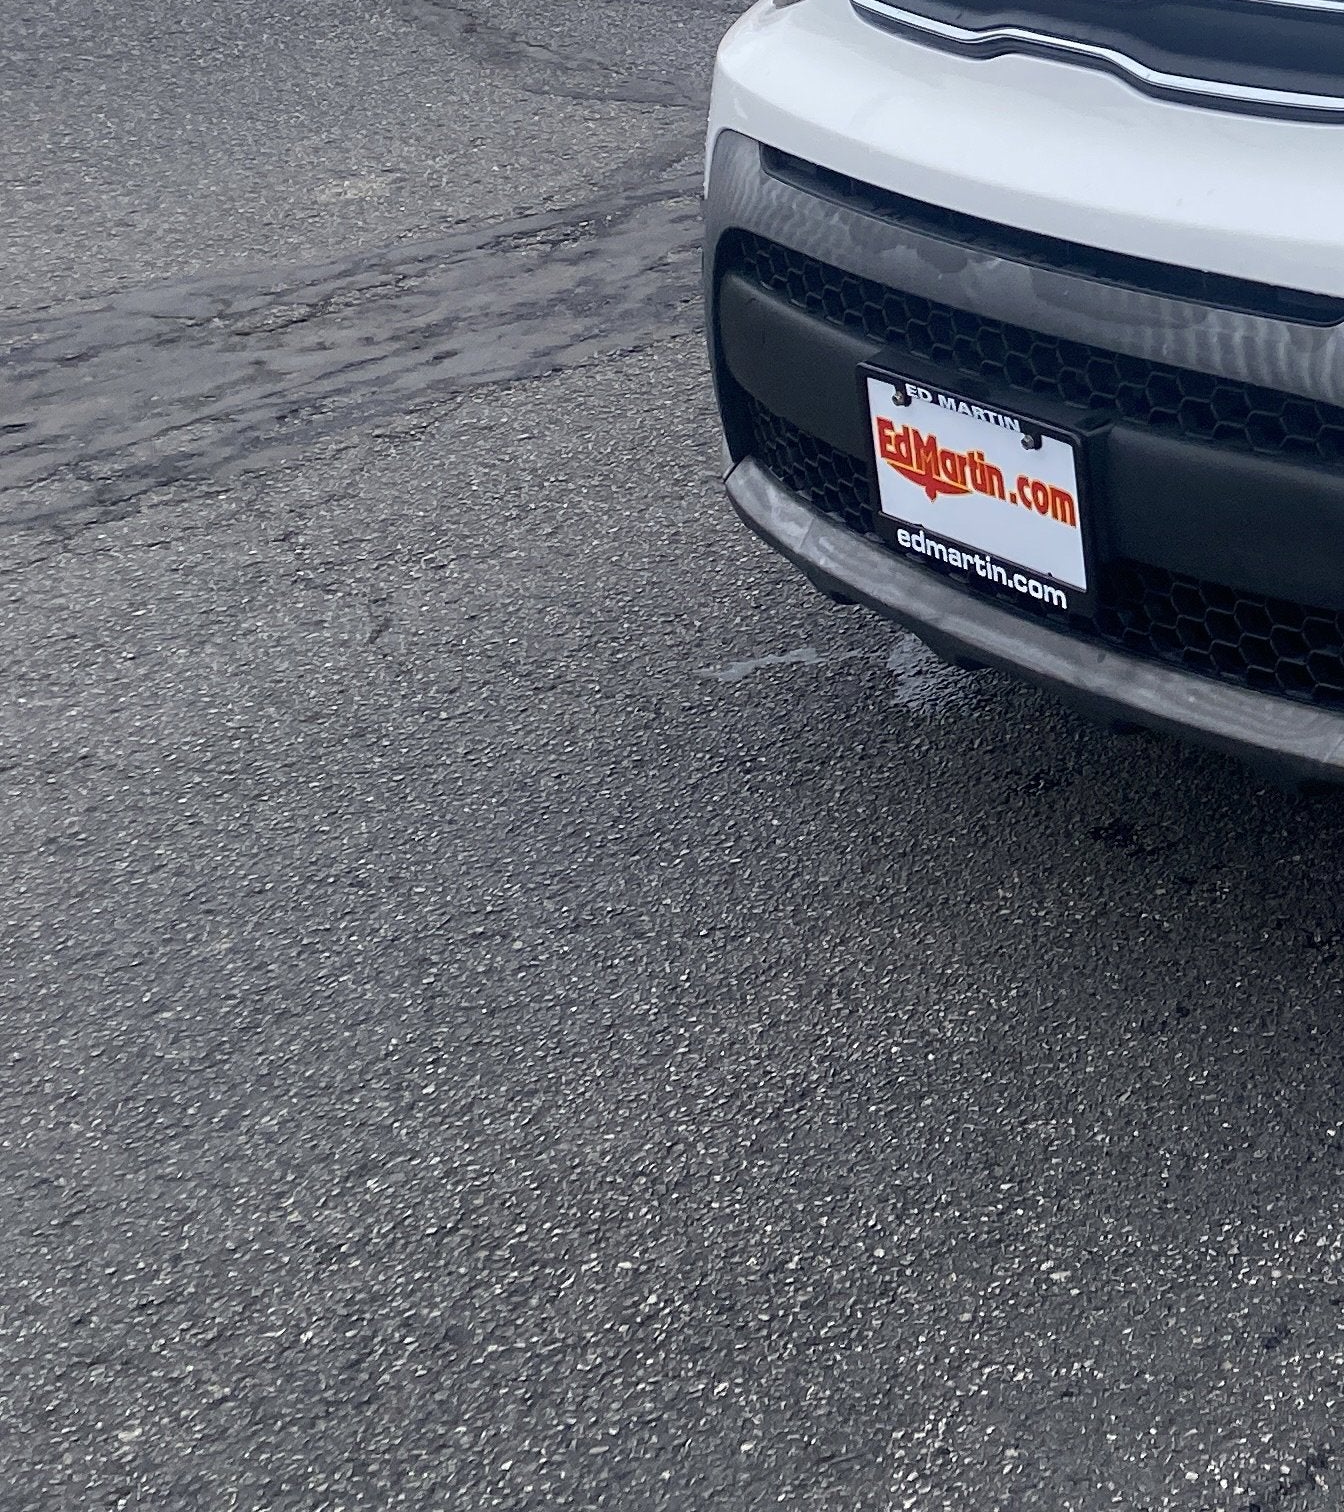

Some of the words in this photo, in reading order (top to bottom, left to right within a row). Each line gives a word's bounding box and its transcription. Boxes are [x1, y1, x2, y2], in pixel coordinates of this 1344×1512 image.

[904, 383, 934, 403] ED
[938, 394, 1022, 432] MARTIN
[896, 527, 1068, 610] edmartin.com
